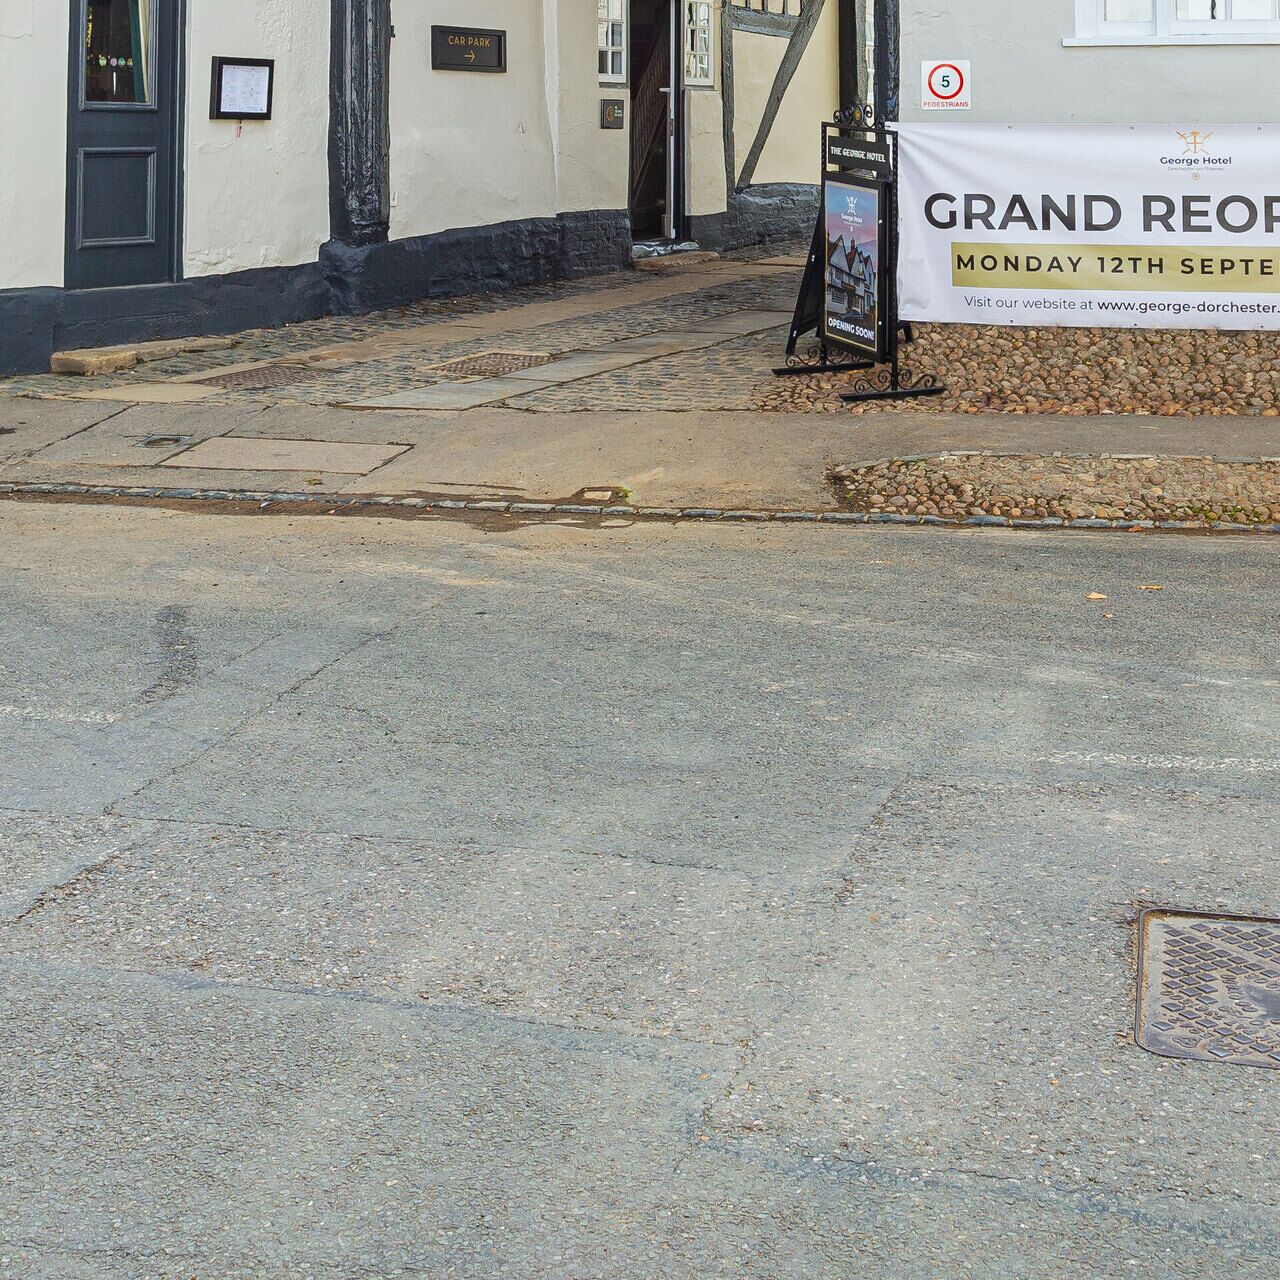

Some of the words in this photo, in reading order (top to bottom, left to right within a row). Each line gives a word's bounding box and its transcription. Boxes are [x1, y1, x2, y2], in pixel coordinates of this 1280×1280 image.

[448, 36, 466, 46] CAR
[468, 37, 491, 47] PARK
[942, 75, 950, 88] 5
[831, 147, 842, 156] THE
[843, 149, 866, 159] GEORGE
[867, 152, 886, 163] HOTEL
[1160, 157, 1200, 166] George
[1203, 157, 1232, 165] Hotel
[924, 192, 1122, 231] GRAND
[956, 254, 1082, 273] MONDAY
[1097, 256, 1164, 274] 12TH
[964, 296, 992, 308] Visit
[995, 299, 1019, 309] our
[1022, 296, 1077, 310] website
[1079, 299, 1094, 310] at
[828, 317, 855, 334] OPENING
